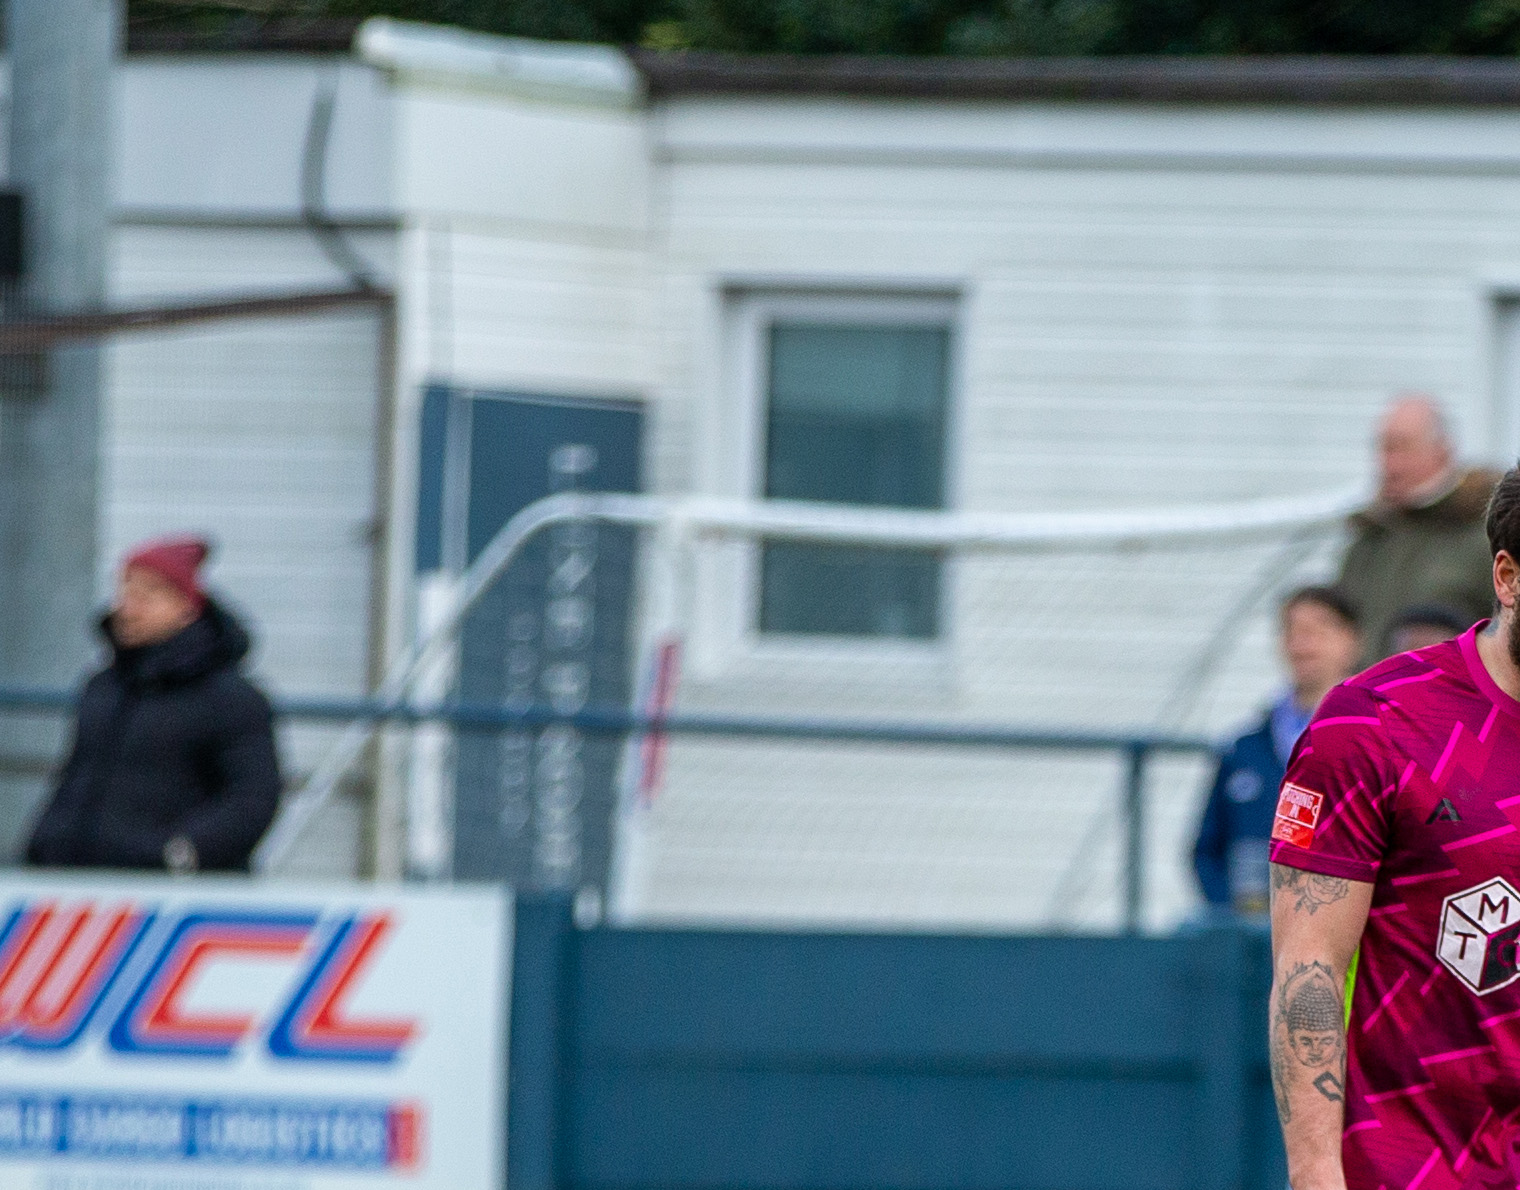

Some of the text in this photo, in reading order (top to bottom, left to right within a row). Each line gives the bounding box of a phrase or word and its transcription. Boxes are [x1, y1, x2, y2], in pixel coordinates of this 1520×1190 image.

[1478, 893, 1509, 924] M
[1454, 931, 1477, 960] T
[0, 901, 421, 1065] WCL
